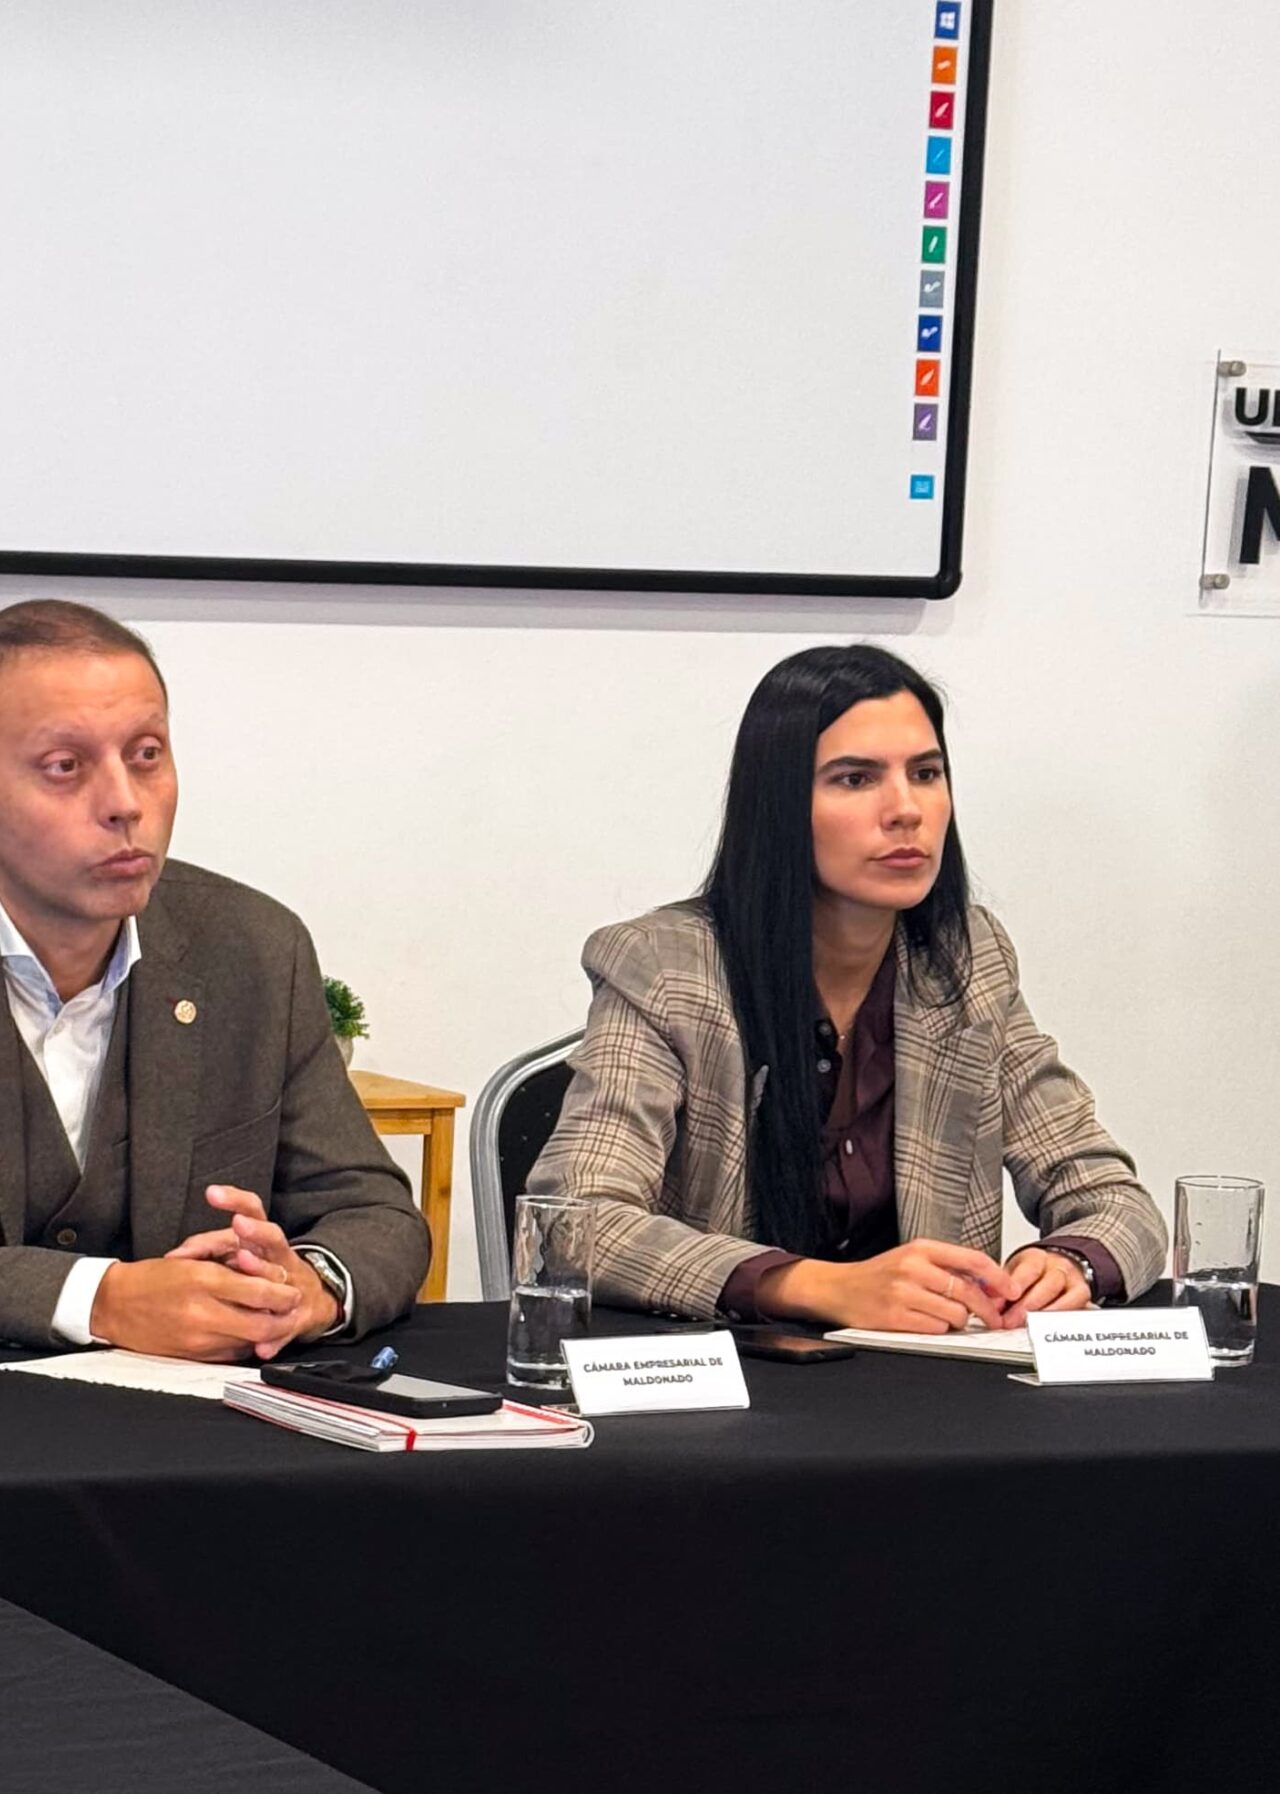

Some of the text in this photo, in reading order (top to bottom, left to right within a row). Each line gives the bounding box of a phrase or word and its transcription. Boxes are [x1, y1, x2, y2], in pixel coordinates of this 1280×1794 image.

[1044, 1330, 1190, 1343] CÁMARA EMPRESARIAL DE
[1084, 1346, 1157, 1357] MALDONADO
[583, 1356, 724, 1373] CÁMARA EMPRESARIAL DE
[623, 1373, 694, 1387] MALDONADO
